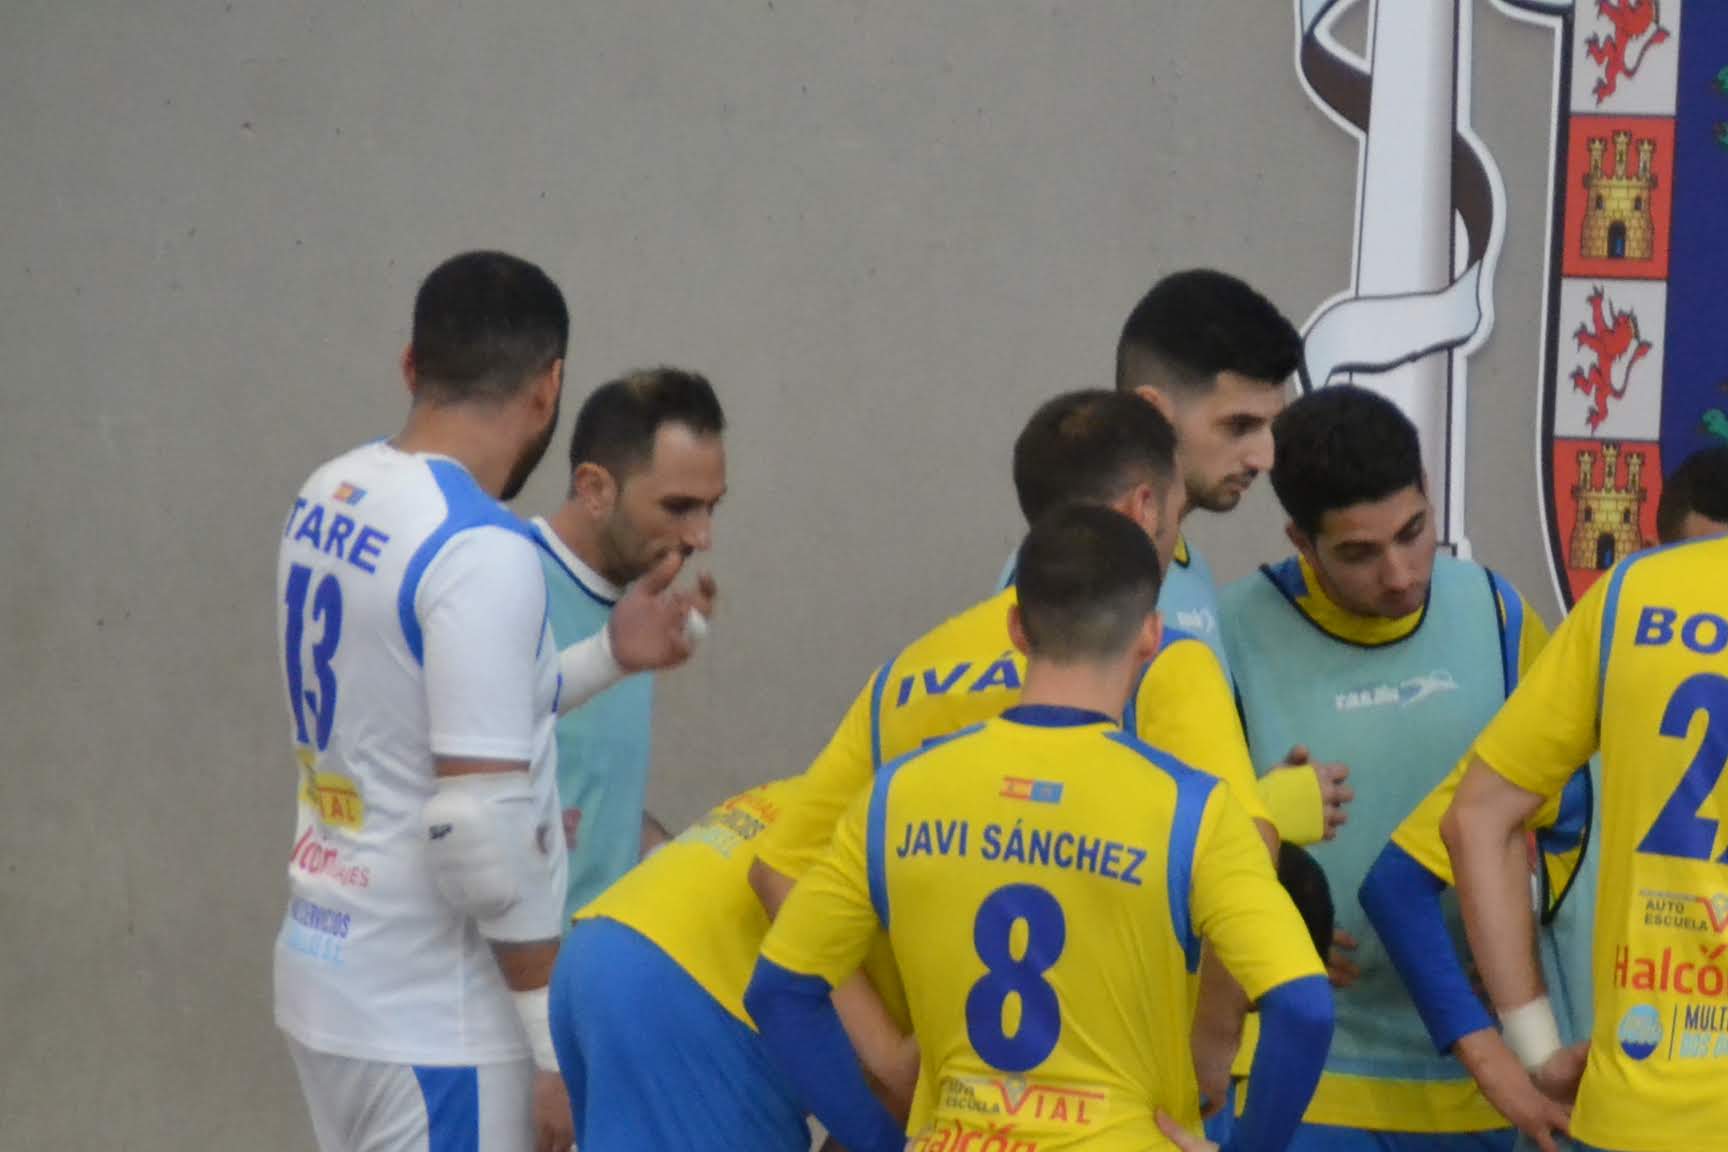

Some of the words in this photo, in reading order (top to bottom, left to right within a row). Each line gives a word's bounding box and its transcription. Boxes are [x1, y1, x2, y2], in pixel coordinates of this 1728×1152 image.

[284, 562, 343, 752] 13
[896, 820, 968, 859] JAVI
[981, 819, 1148, 887] SÁNCHEZ
[965, 883, 1066, 1073] 8
[995, 1079, 1103, 1125] VIAL
